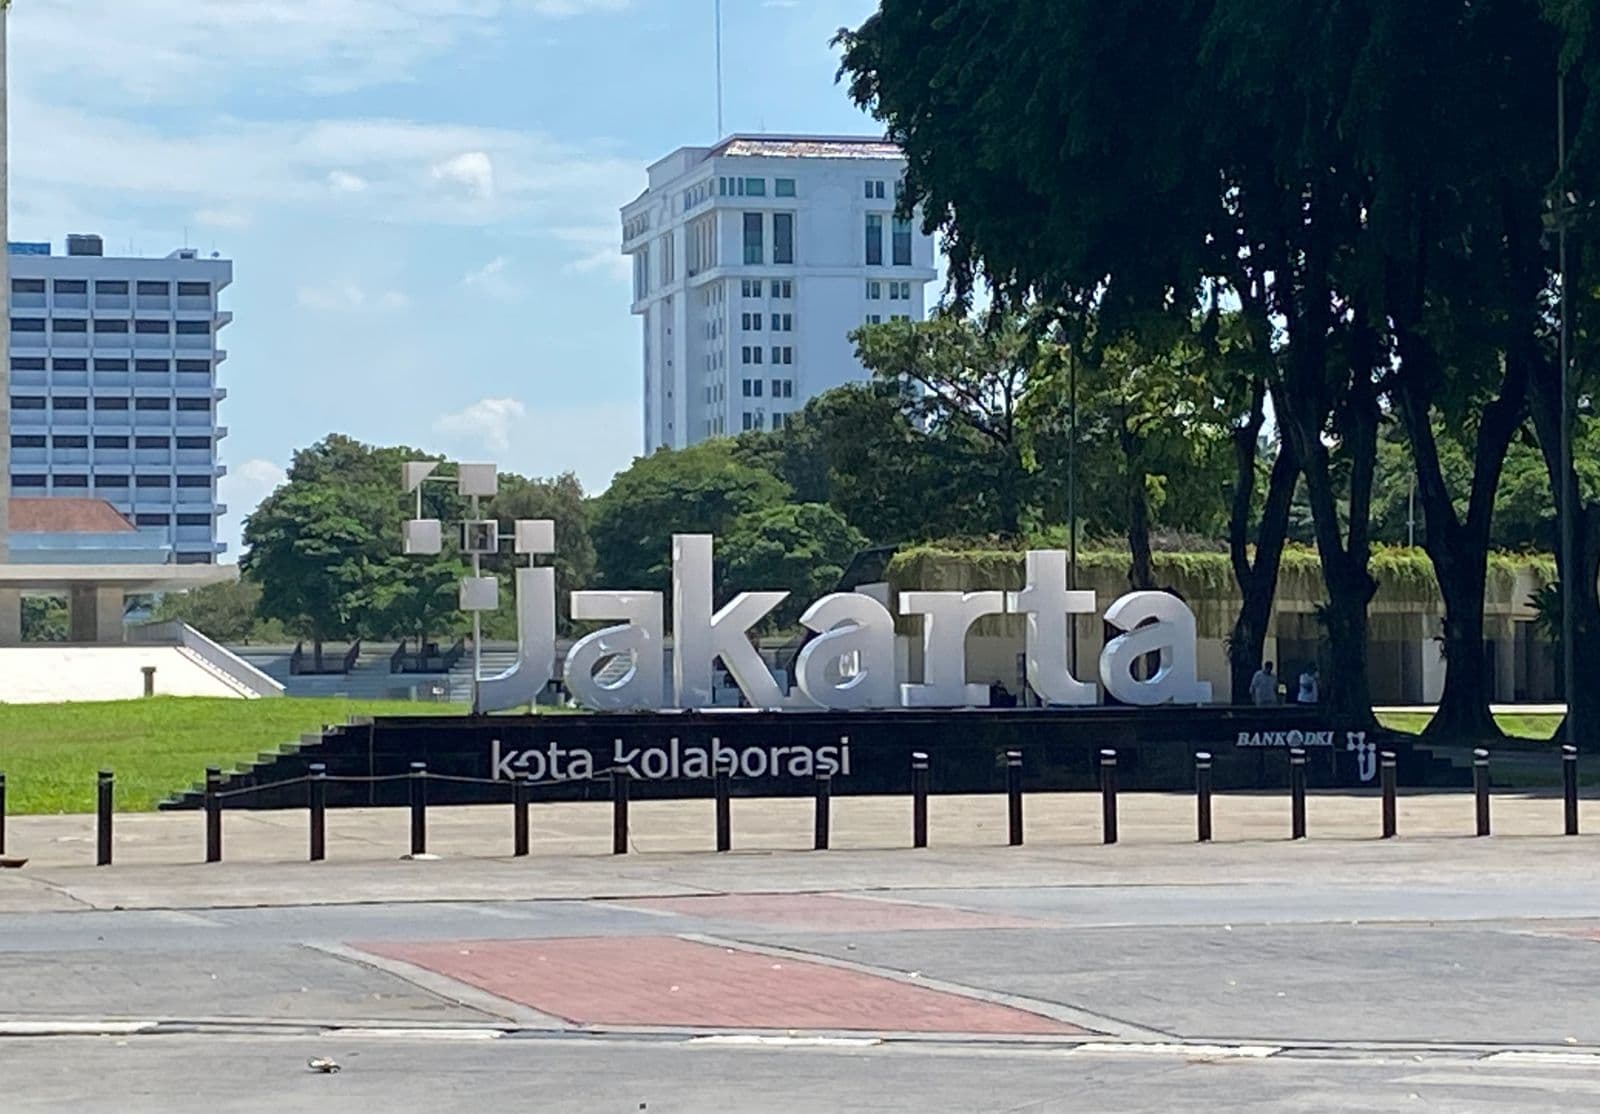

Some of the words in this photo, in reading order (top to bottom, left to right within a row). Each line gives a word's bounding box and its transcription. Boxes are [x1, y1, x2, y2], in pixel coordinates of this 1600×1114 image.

[476, 519, 1213, 714] jakarta
[492, 740, 593, 780] kota
[614, 737, 850, 779] kolaborasi
[1236, 731, 1287, 746] BANK
[1304, 731, 1334, 746] DKI
